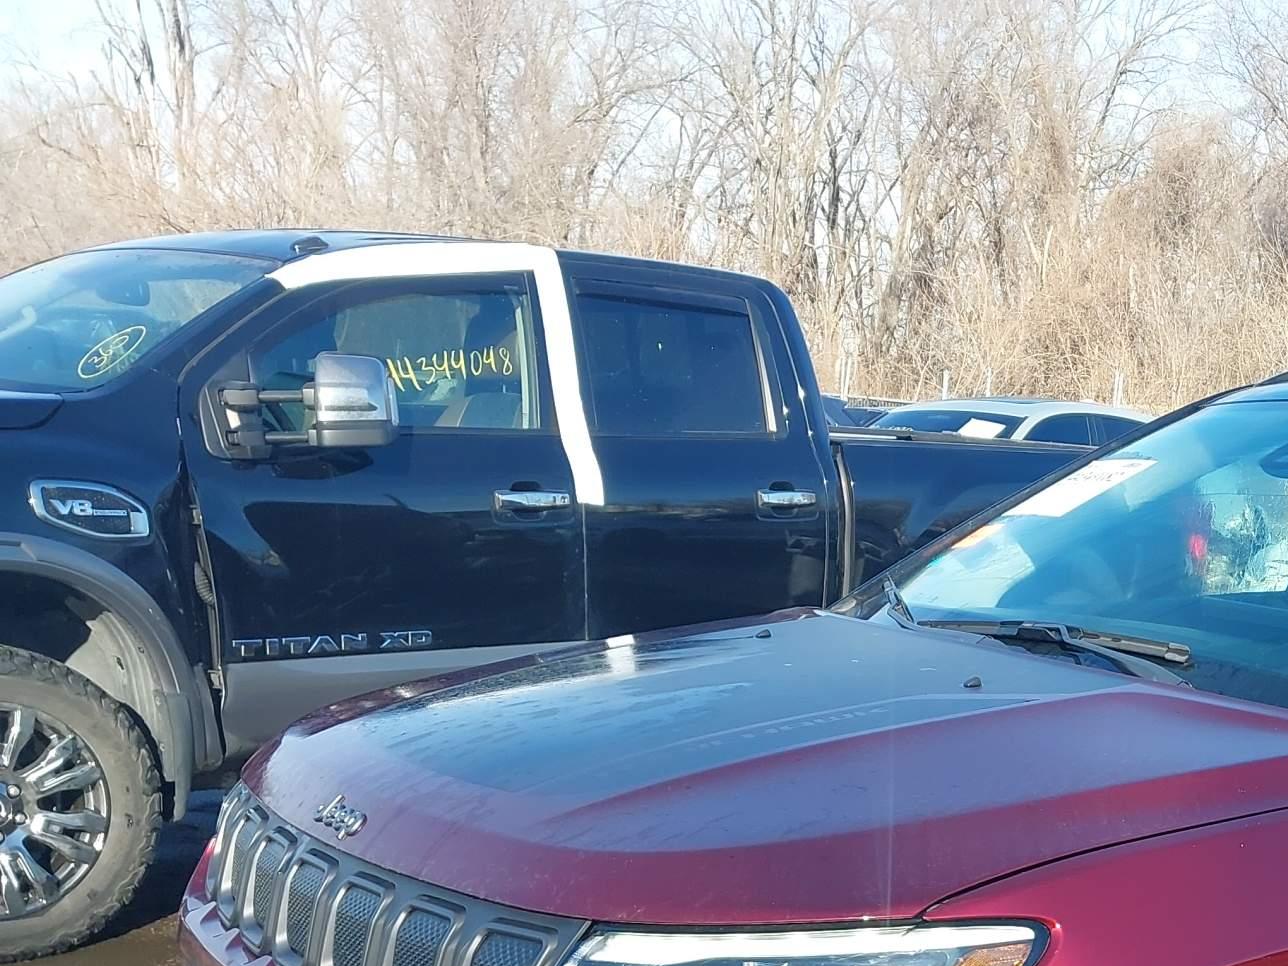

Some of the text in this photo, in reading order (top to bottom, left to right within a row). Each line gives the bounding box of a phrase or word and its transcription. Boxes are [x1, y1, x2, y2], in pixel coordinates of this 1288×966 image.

[48, 499, 93, 516] V8
[232, 630, 432, 657] TITAN XD
[313, 794, 367, 840] Jeep
